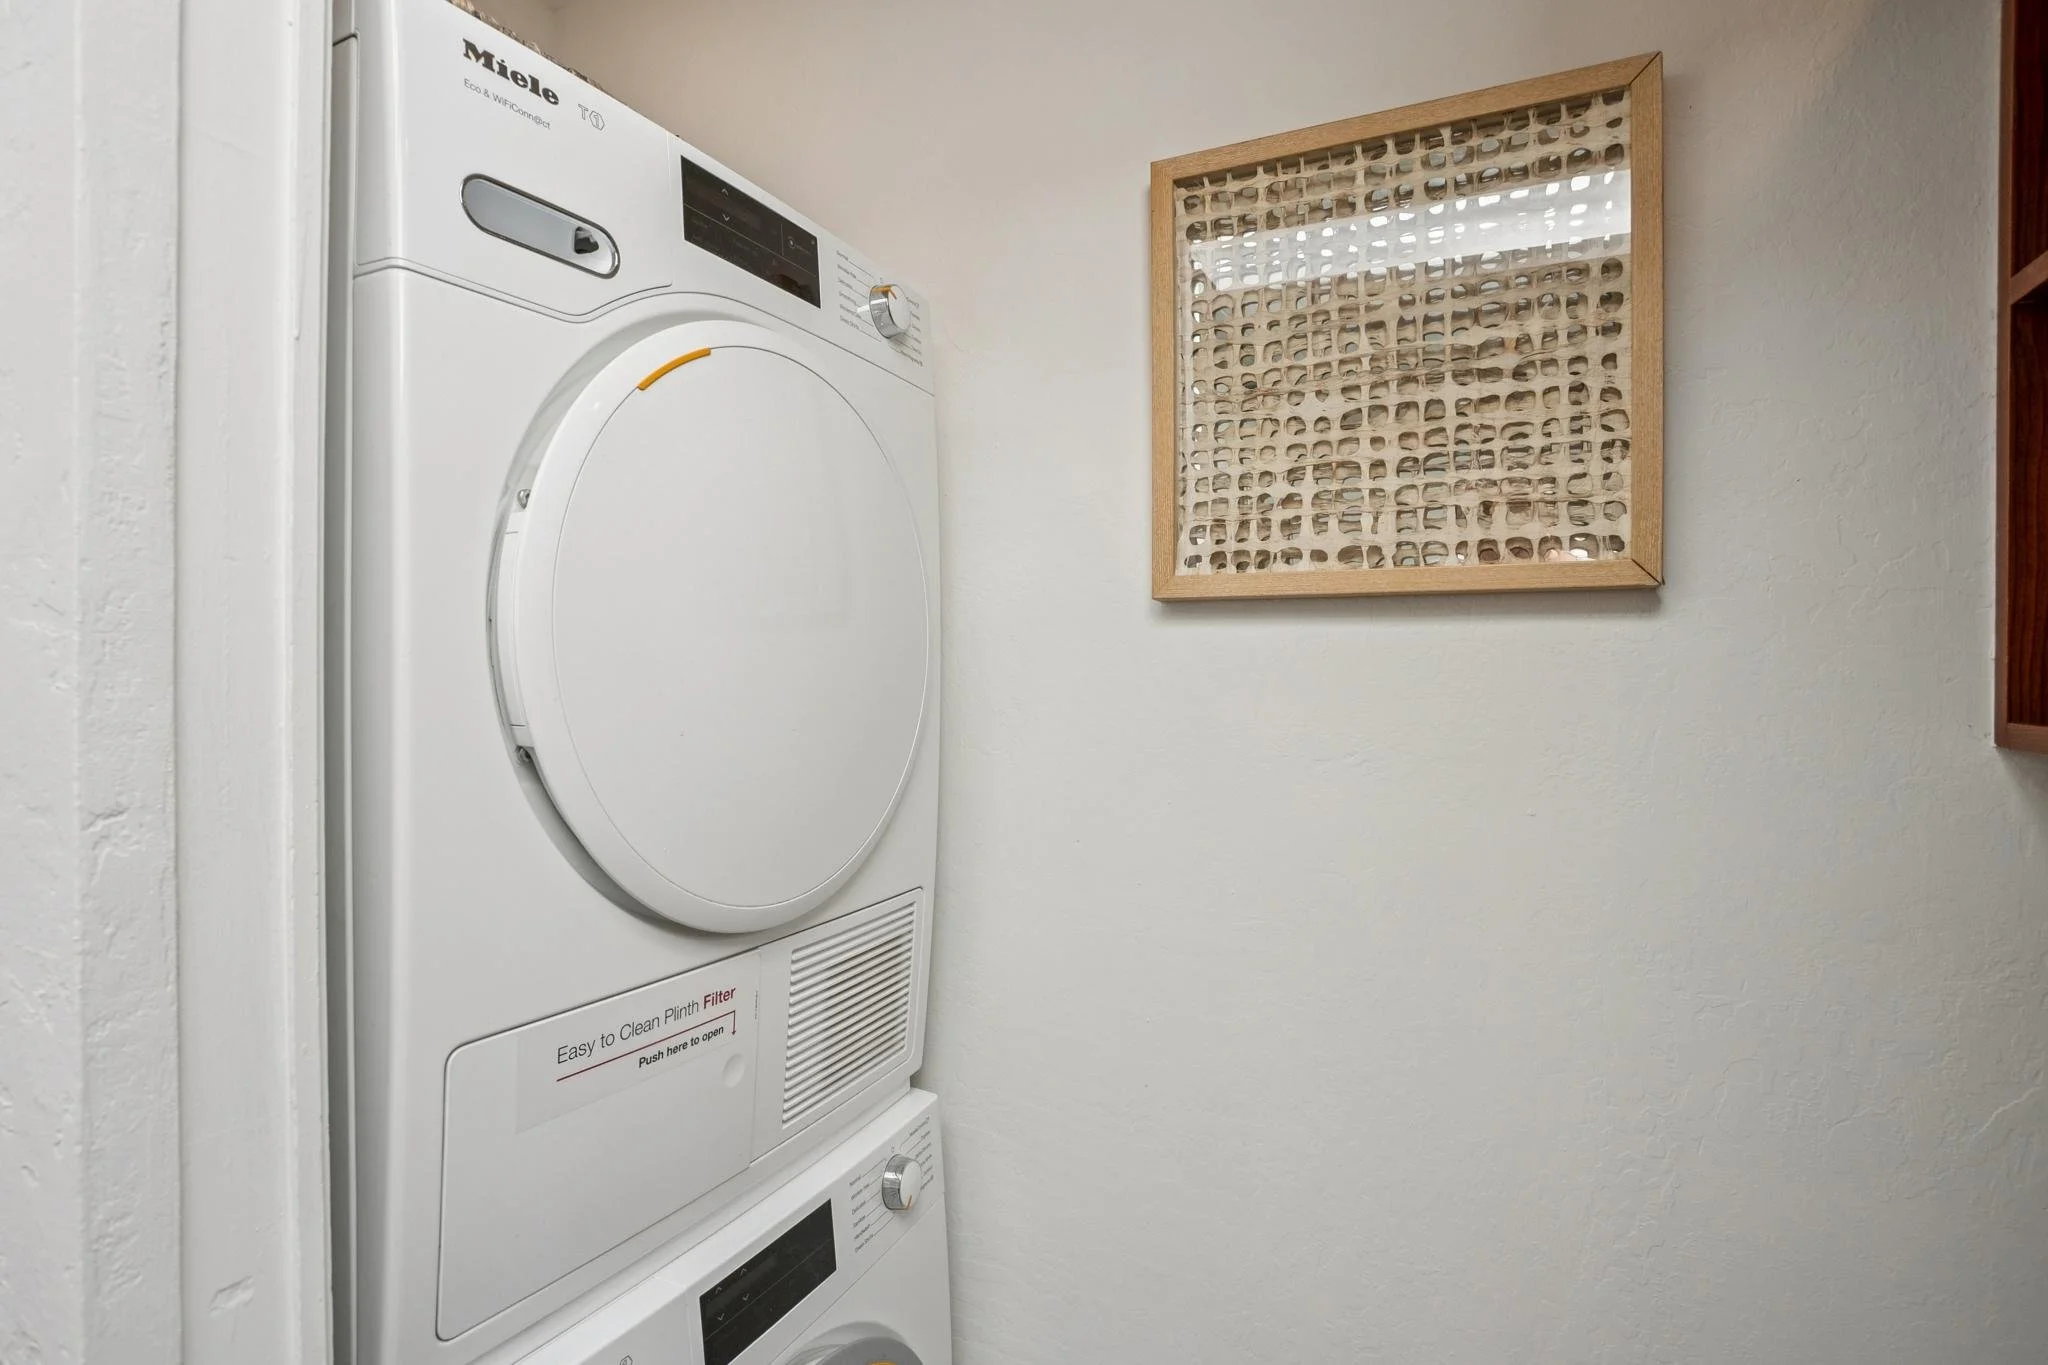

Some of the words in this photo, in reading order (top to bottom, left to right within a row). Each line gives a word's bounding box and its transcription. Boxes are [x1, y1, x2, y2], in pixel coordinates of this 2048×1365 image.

[462, 38, 560, 106] Miele
[463, 78, 482, 94] Eco
[483, 88, 490, 98] &
[557, 1039, 596, 1065] Easy
[600, 1032, 615, 1049] to
[619, 1016, 660, 1041] Clean
[664, 1000, 699, 1025] Plinth
[703, 987, 737, 1010] Filter
[638, 1050, 664, 1069] Push
[666, 1042, 689, 1057] here
[690, 1036, 700, 1047] to
[702, 1025, 724, 1042] open
